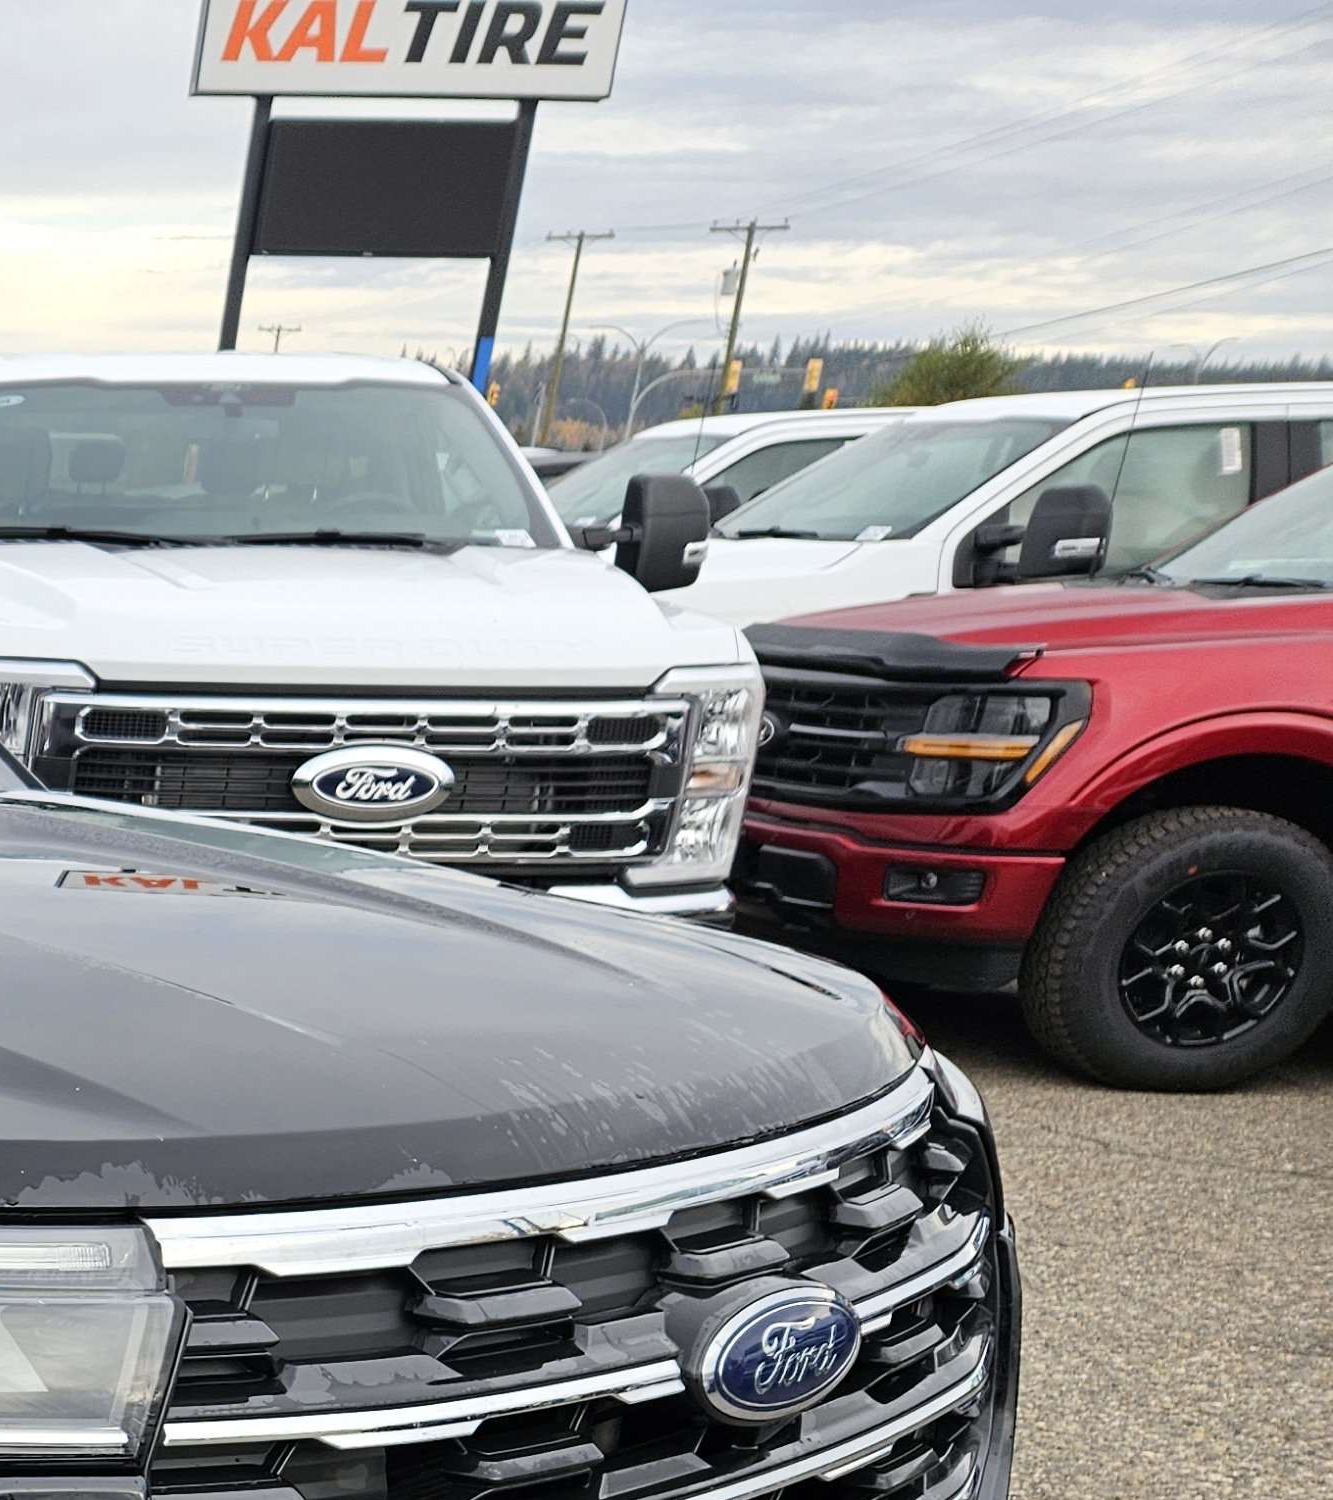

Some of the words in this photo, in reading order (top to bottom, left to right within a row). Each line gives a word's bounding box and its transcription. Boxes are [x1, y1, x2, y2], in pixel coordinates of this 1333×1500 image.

[221, 0, 389, 62] KAL
[403, 0, 605, 66] TIRE
[336, 766, 416, 801] Ford
[753, 1315, 839, 1396] Ford
